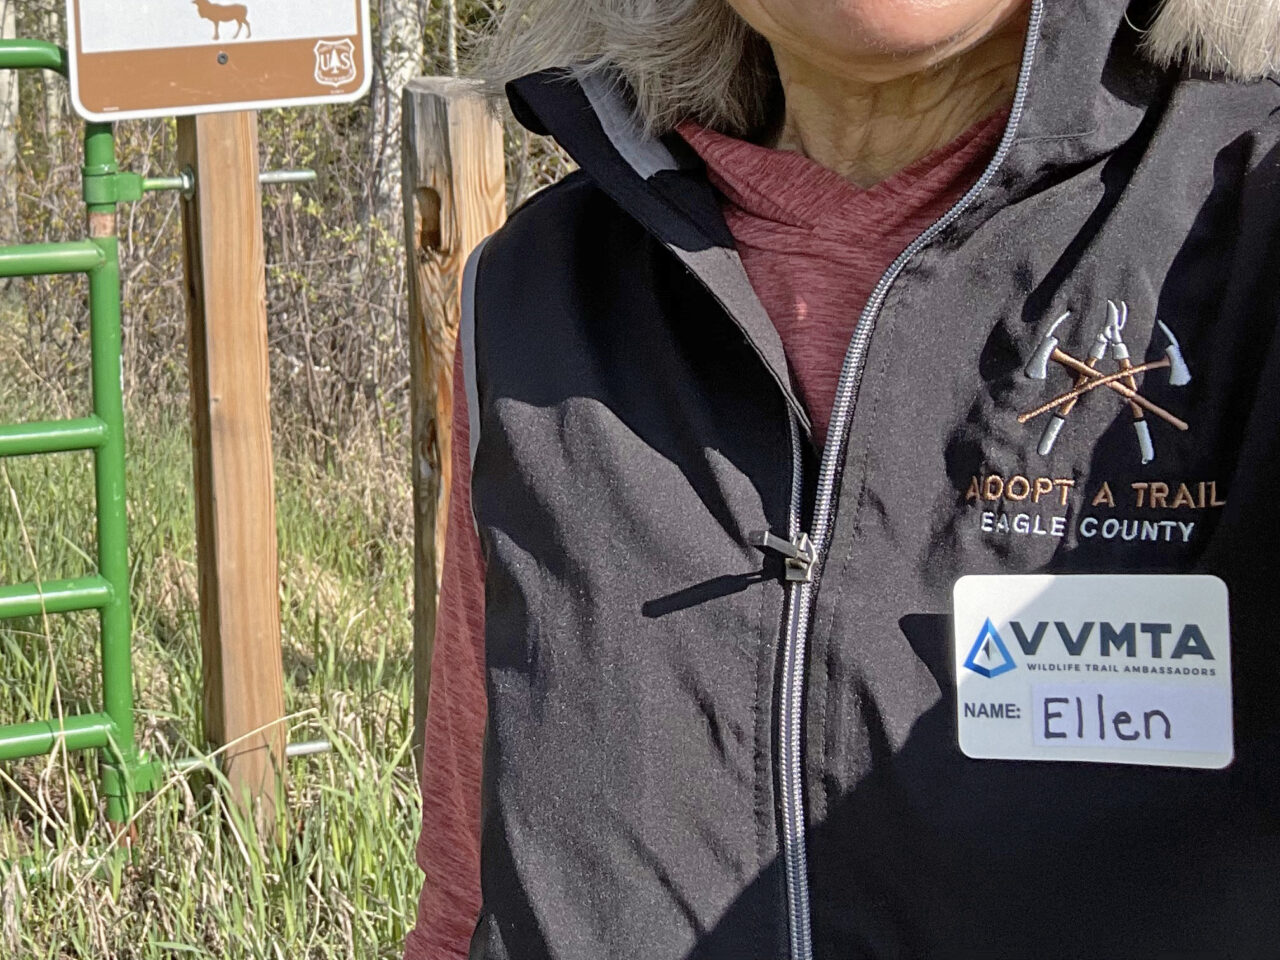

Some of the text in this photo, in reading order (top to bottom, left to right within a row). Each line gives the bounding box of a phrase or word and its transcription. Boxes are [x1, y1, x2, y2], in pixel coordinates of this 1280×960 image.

[965, 475, 1226, 509] ADOPT A TRAIL
[981, 511, 1195, 542] EAGLE COUNTY
[1009, 621, 1216, 661] VVMTA
[1027, 663, 1216, 677] WILDLIFE TRAIL AMBASSADORS
[964, 702, 1021, 719] NAME:
[1043, 694, 1171, 741] Ellen
